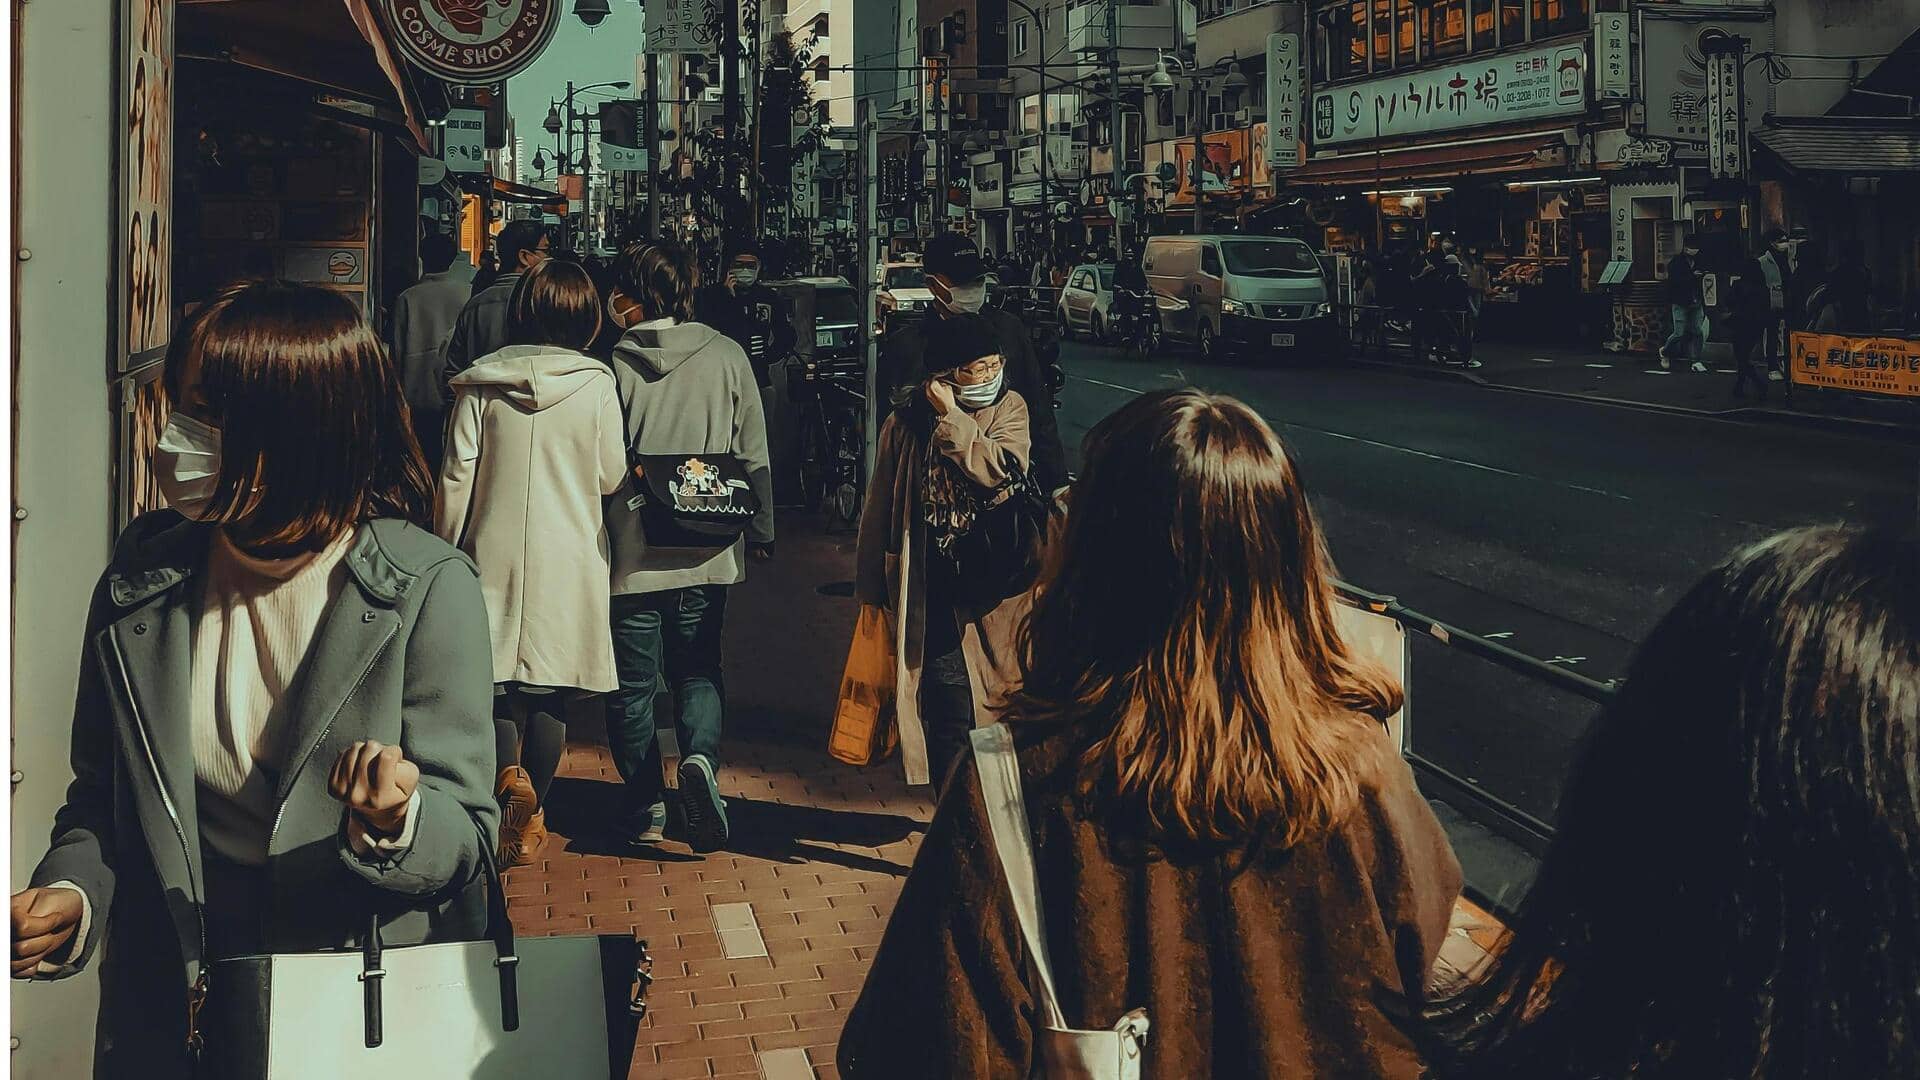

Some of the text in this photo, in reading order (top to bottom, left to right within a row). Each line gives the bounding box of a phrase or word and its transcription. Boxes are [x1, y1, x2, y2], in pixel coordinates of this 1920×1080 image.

[401, 6, 514, 65] COSME SHOP
[1515, 56, 1550, 76] 年中無休
[1278, 57, 1294, 142] ソウル市場
[1377, 68, 1499, 124] ソウル市場
[460, 120, 482, 130] CHICKEN
